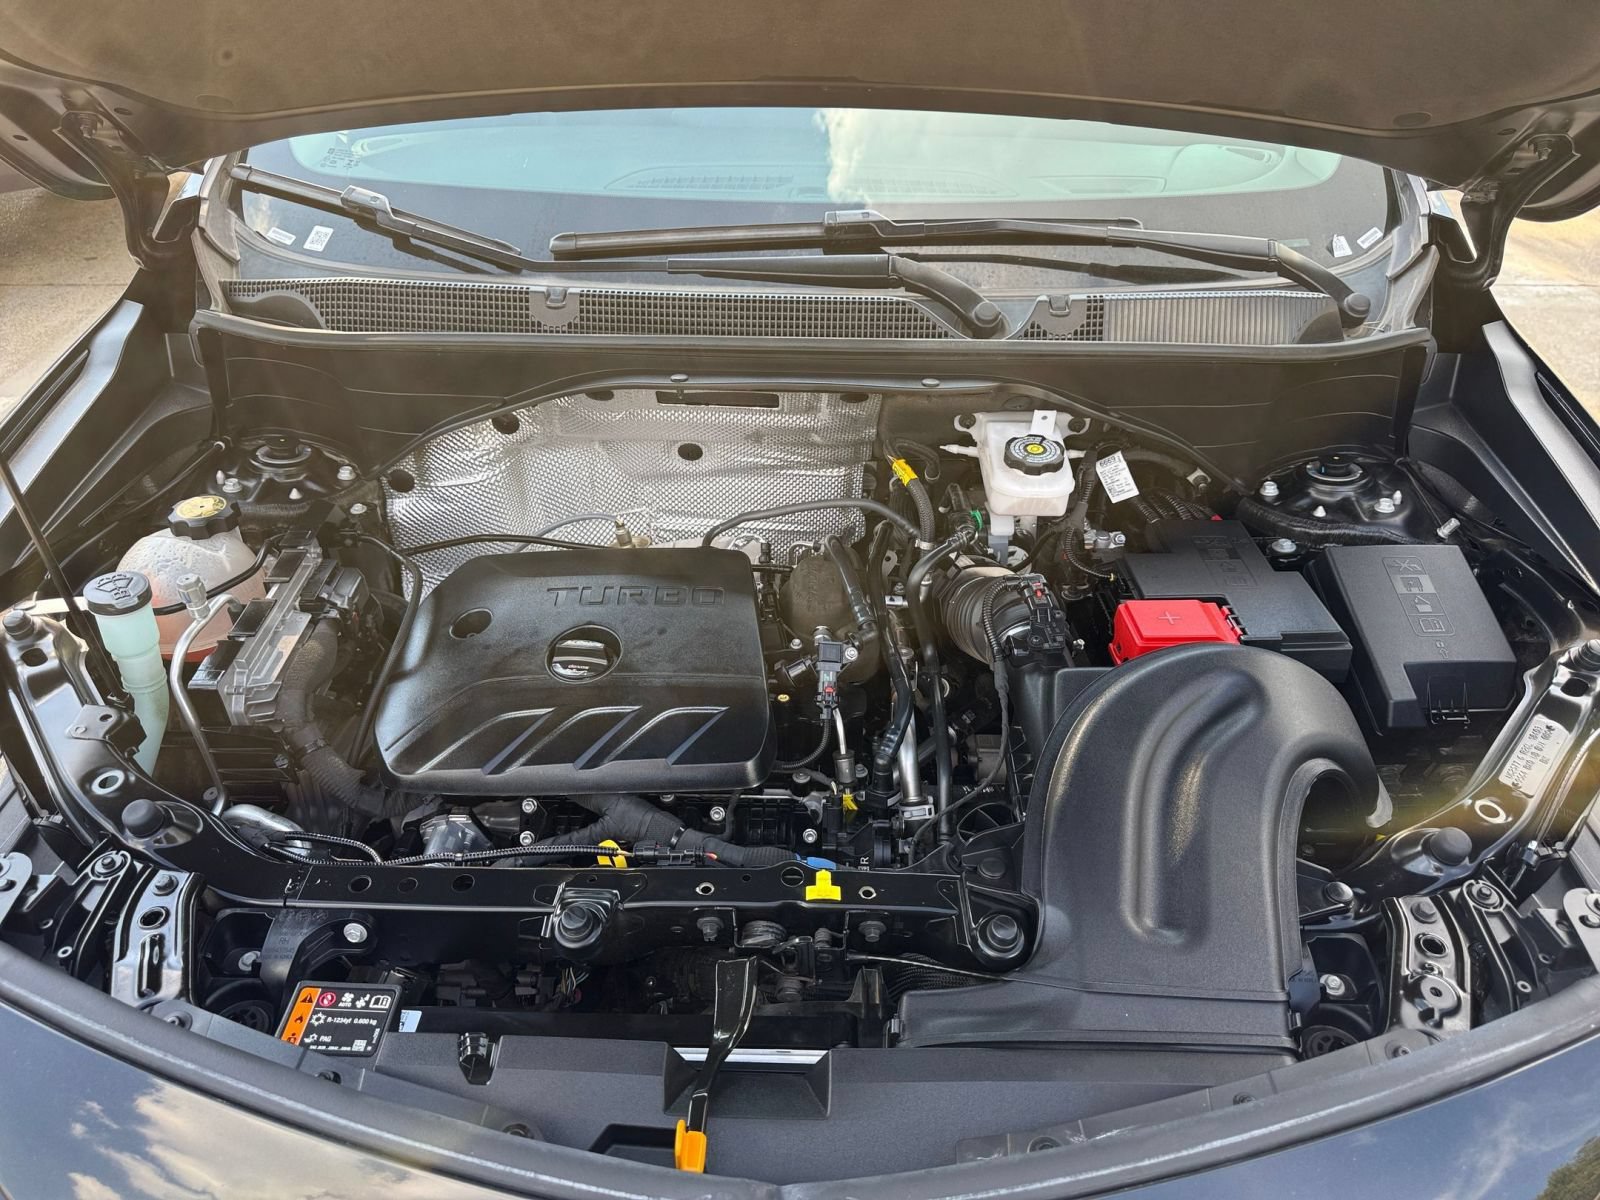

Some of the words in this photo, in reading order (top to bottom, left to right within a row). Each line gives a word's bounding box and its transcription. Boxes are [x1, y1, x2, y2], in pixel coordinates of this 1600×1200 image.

[547, 586, 725, 607] TURBO
[860, 856, 869, 865] R
[326, 1016, 352, 1024] R-1234yf
